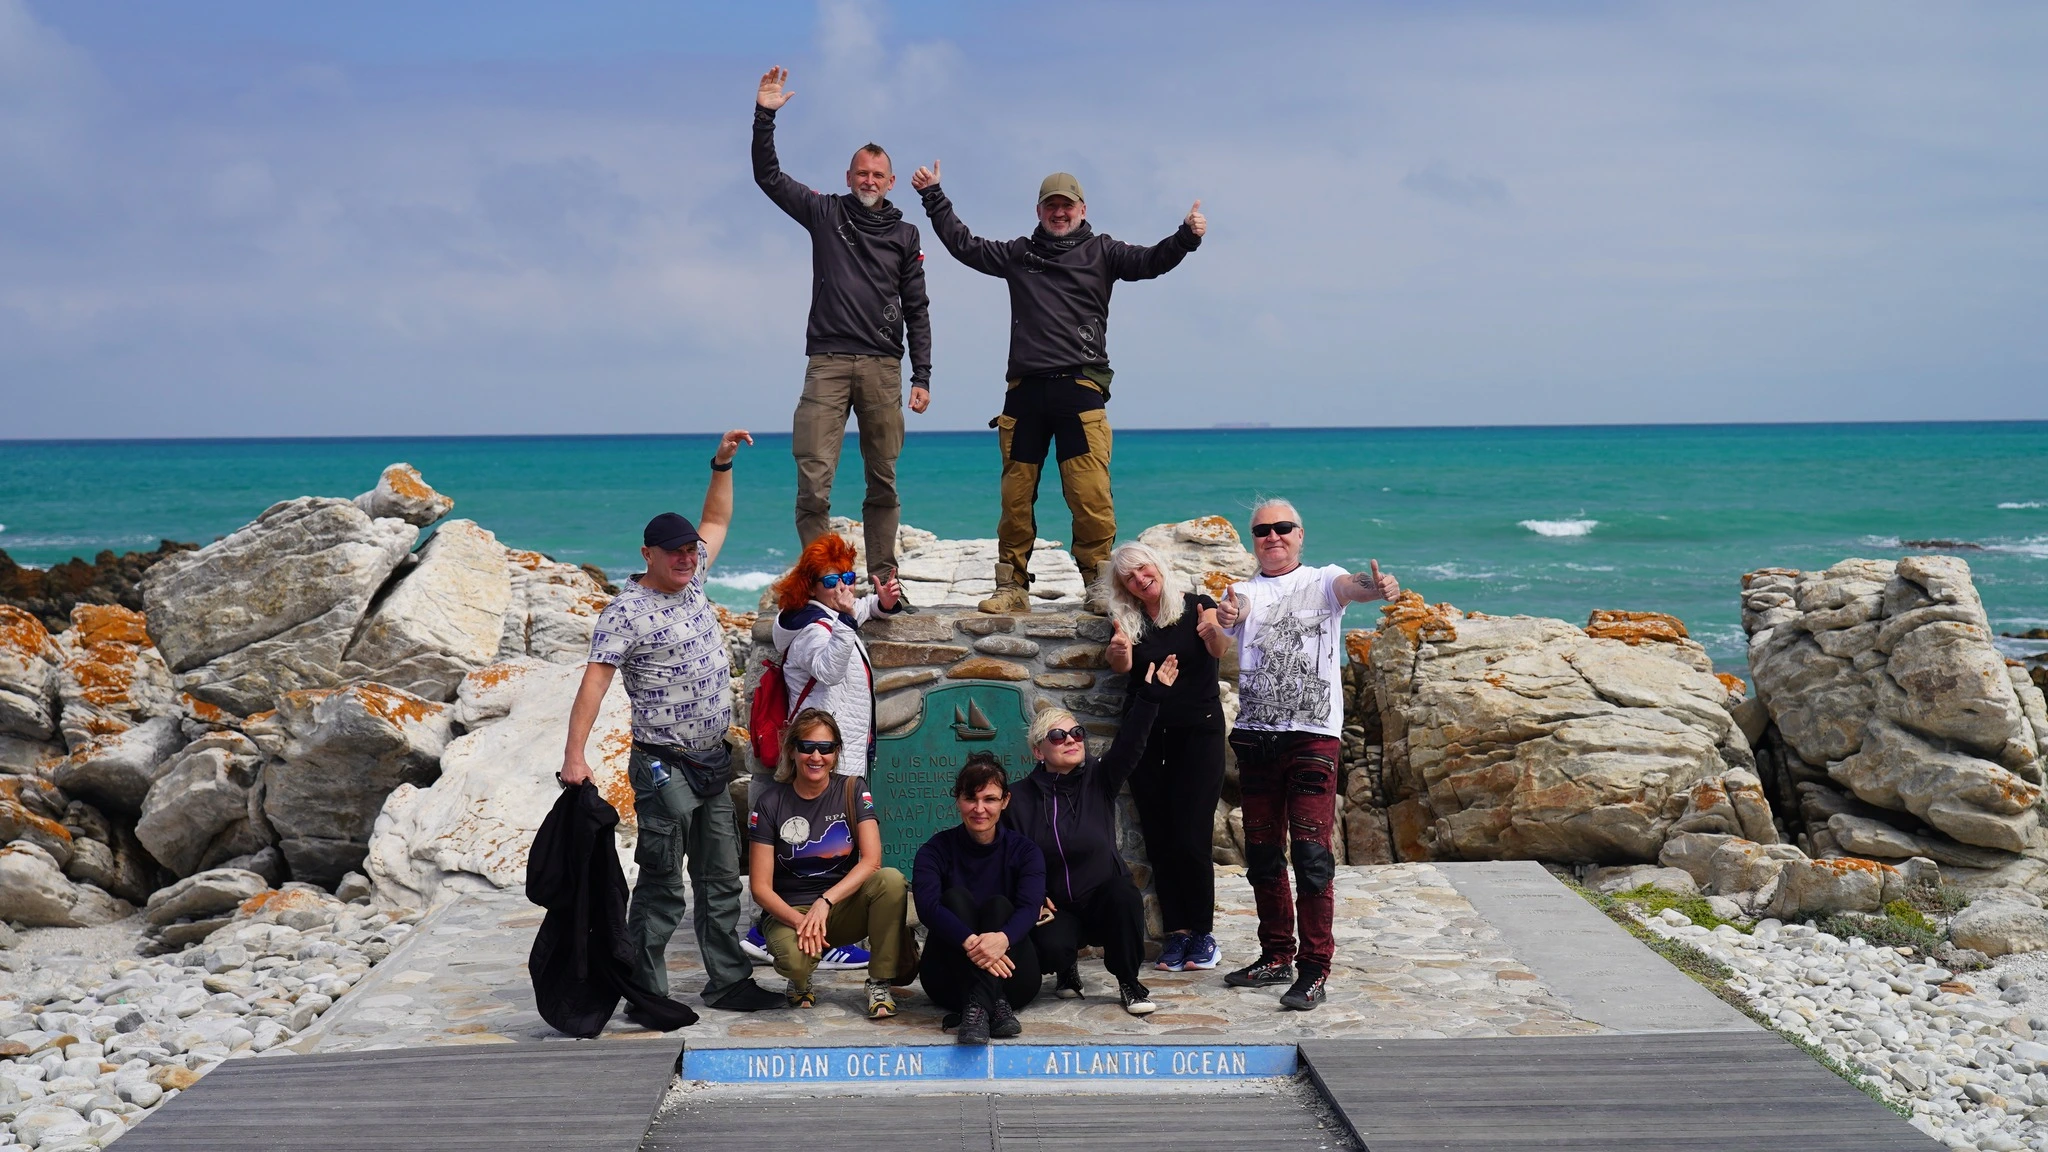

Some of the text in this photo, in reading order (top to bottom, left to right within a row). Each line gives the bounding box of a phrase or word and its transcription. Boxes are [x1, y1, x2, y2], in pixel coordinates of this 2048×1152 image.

[892, 756, 901, 768] U
[909, 756, 921, 768] IS
[929, 755, 957, 767] NOU
[886, 771, 954, 784] SUIDELIKE
[890, 787, 949, 799] VASTELA
[825, 812, 847, 822] RPA
[897, 827, 923, 839] YOU
[749, 1052, 923, 1078] INDIAN OCEAN
[1045, 1051, 1246, 1075] ATLANTIC OCEAN
